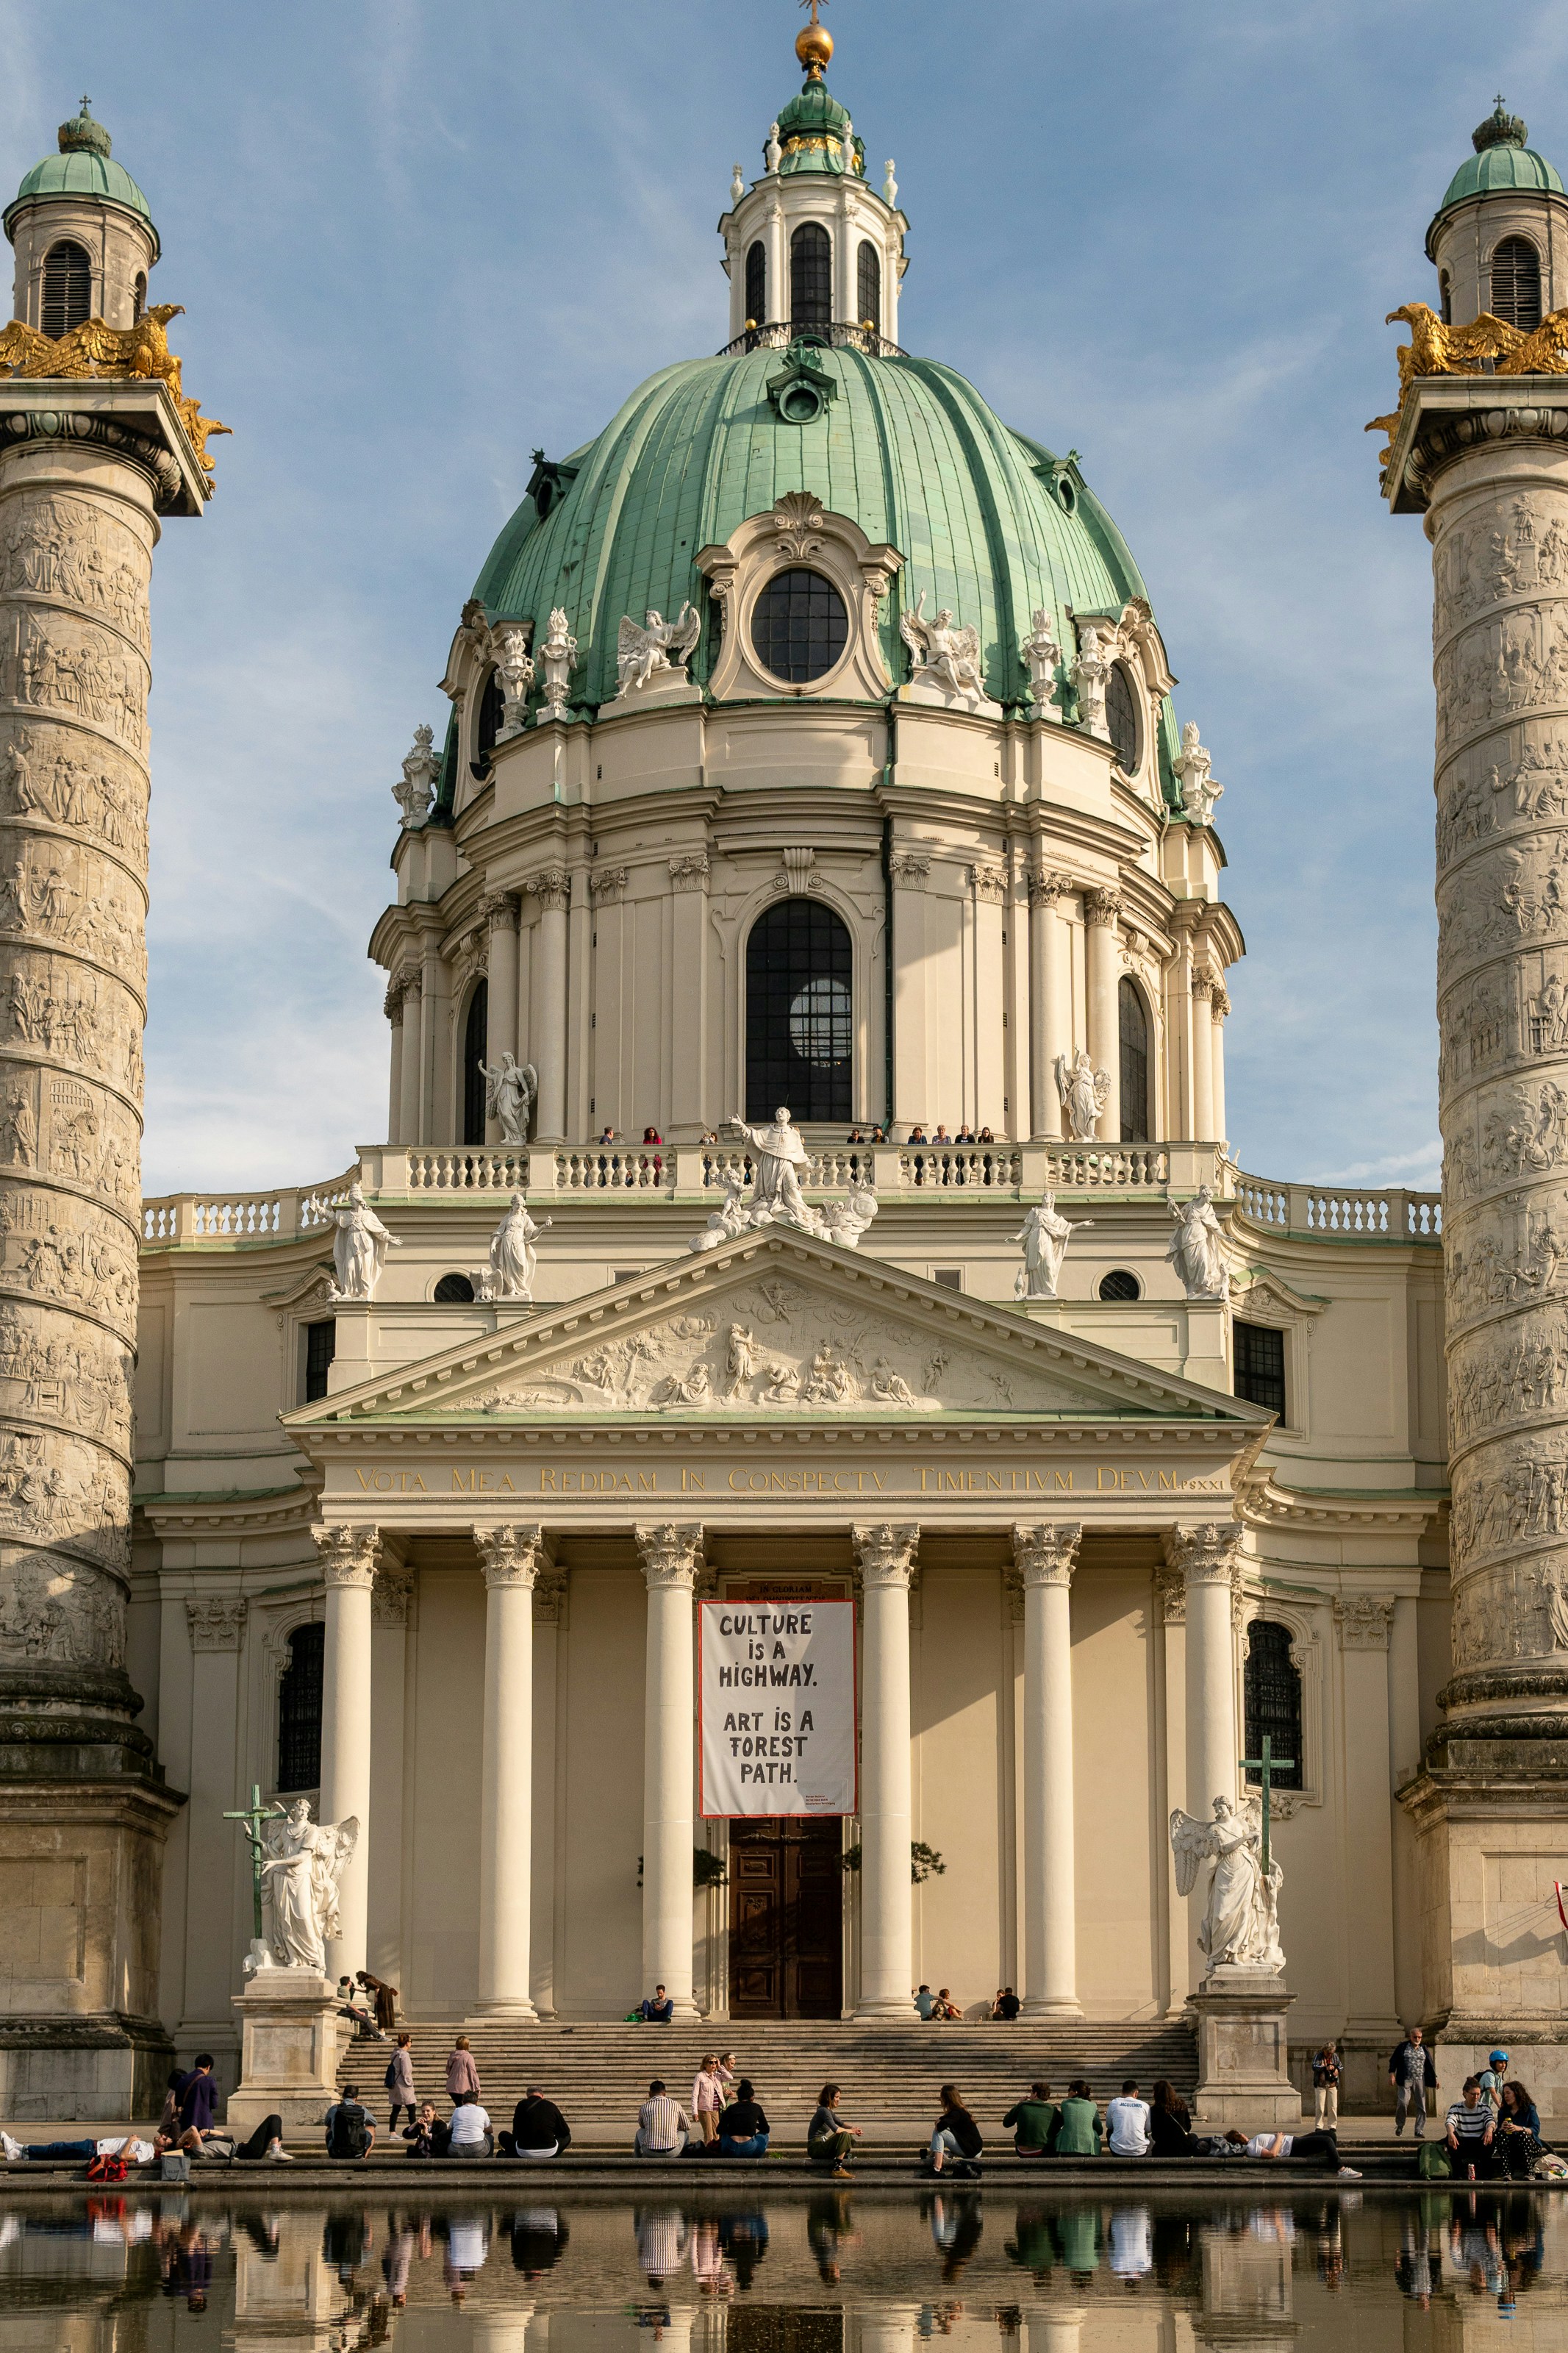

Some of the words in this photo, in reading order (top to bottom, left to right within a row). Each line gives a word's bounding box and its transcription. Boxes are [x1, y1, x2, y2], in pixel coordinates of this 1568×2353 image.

[354, 1468, 428, 1492] VOTA
[452, 1468, 516, 1492] MEA
[540, 1468, 656, 1492] REDDAM
[681, 1468, 706, 1492] IN
[728, 1468, 889, 1492] CONSPECTV
[914, 1468, 1073, 1491] TIMENTIVM
[719, 1614, 812, 1636] CULTURE
[772, 1640, 786, 1660] A
[723, 1712, 764, 1732] ART
[799, 1710, 814, 1732] A
[729, 1736, 808, 1757] FOREST
[740, 1763, 798, 1784] PATH.
